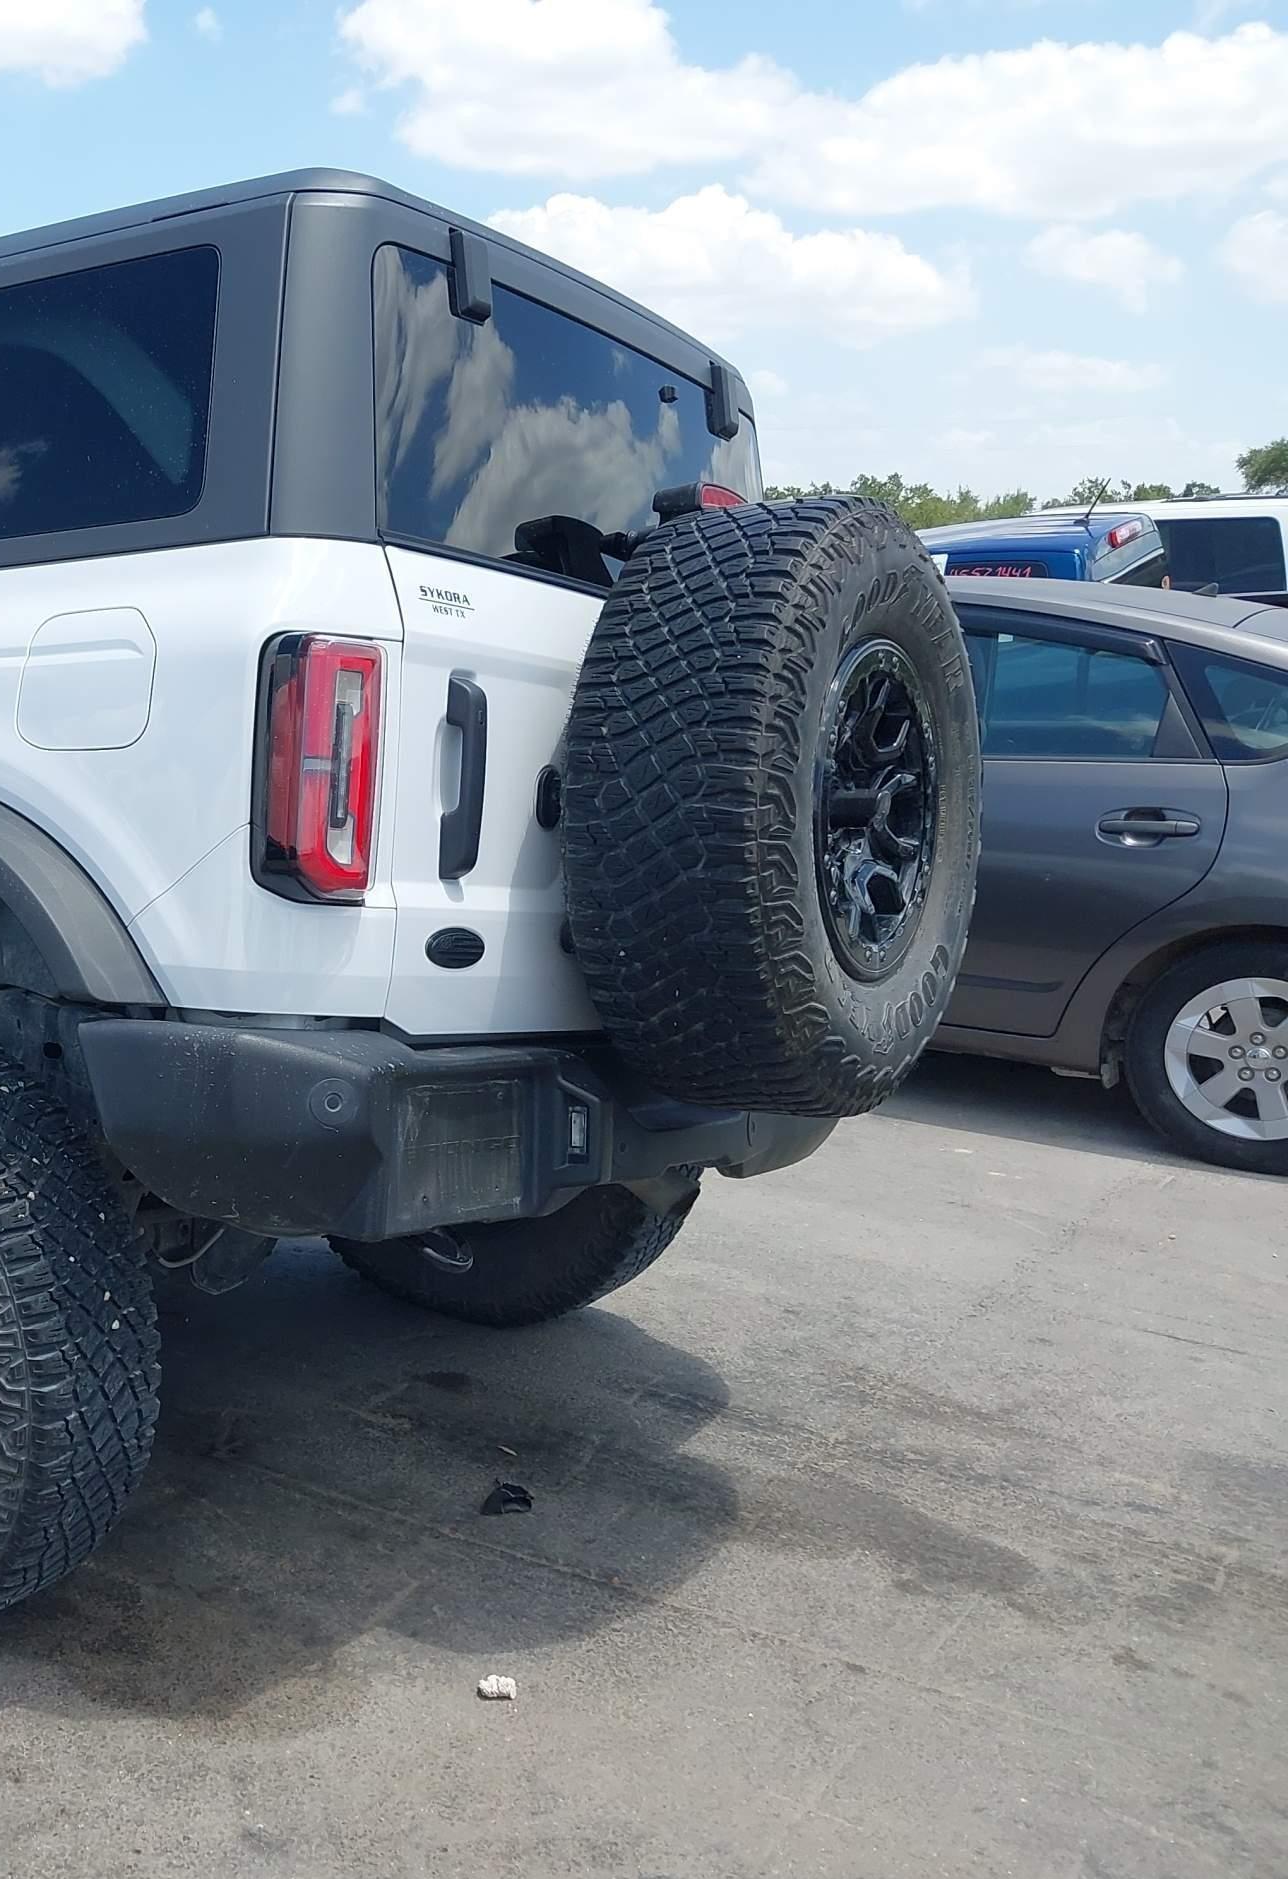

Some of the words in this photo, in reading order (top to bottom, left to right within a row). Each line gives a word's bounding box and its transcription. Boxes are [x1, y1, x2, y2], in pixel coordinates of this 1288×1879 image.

[419, 585, 471, 606] SYKORA
[432, 605, 453, 616] WEST
[455, 609, 466, 619] TX
